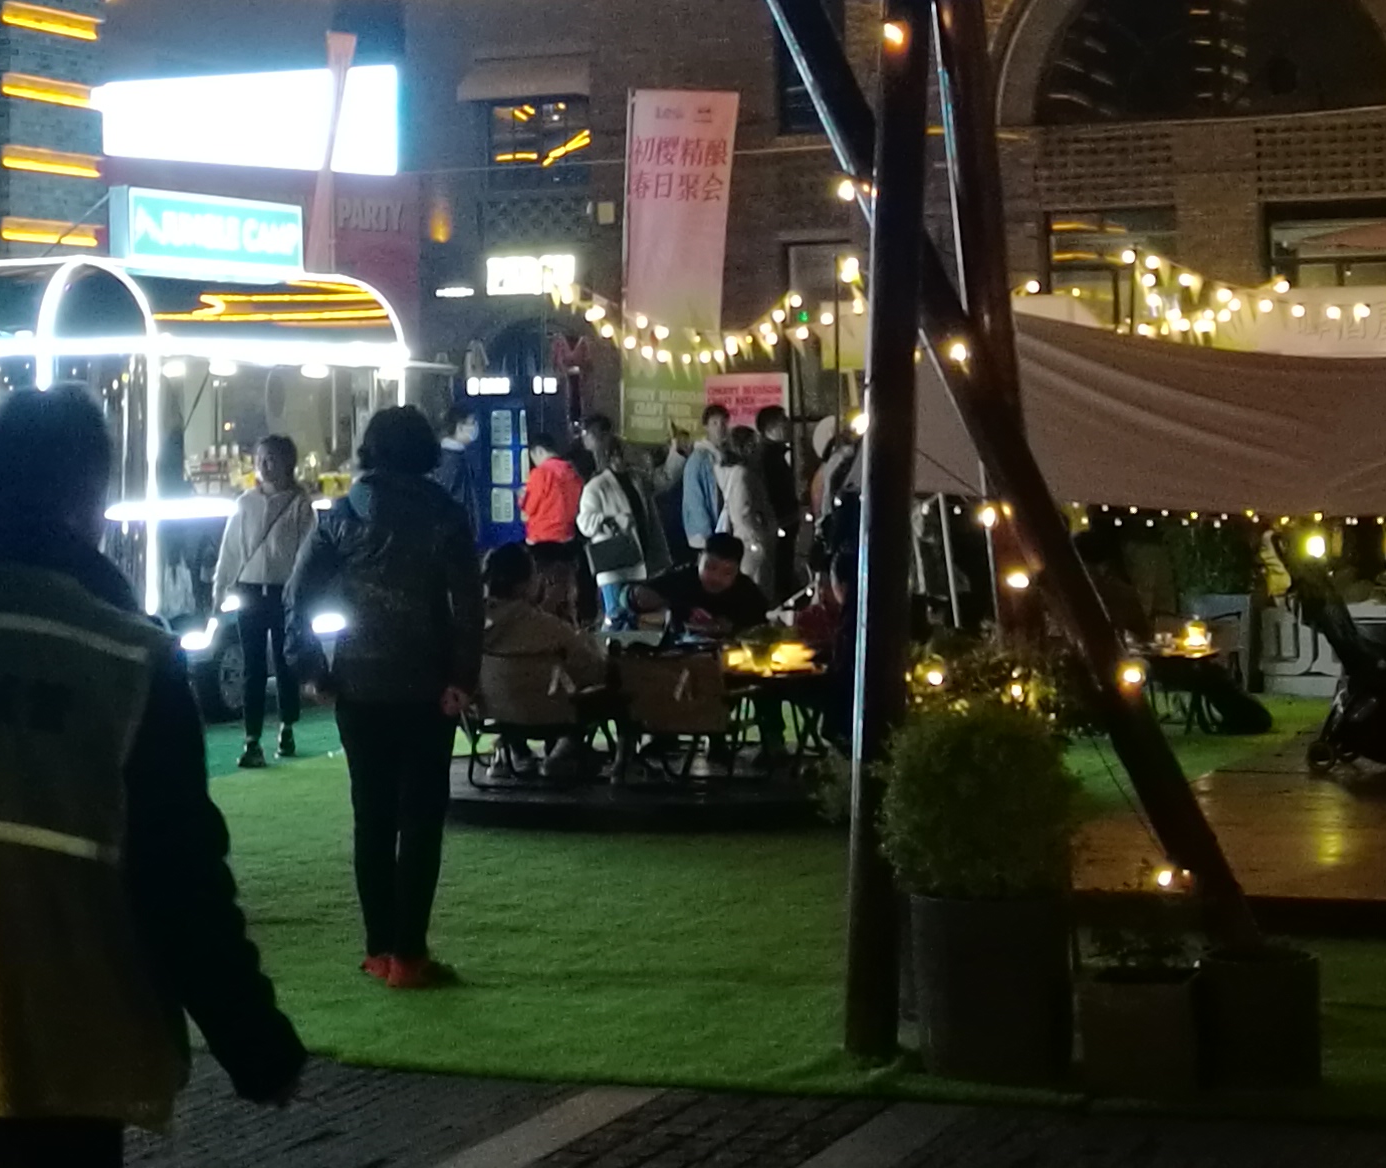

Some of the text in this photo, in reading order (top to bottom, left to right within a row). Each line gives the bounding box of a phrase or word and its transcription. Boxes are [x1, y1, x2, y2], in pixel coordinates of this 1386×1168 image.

[631, 171, 724, 202] 春日聚会
[336, 199, 406, 232] PARTY
